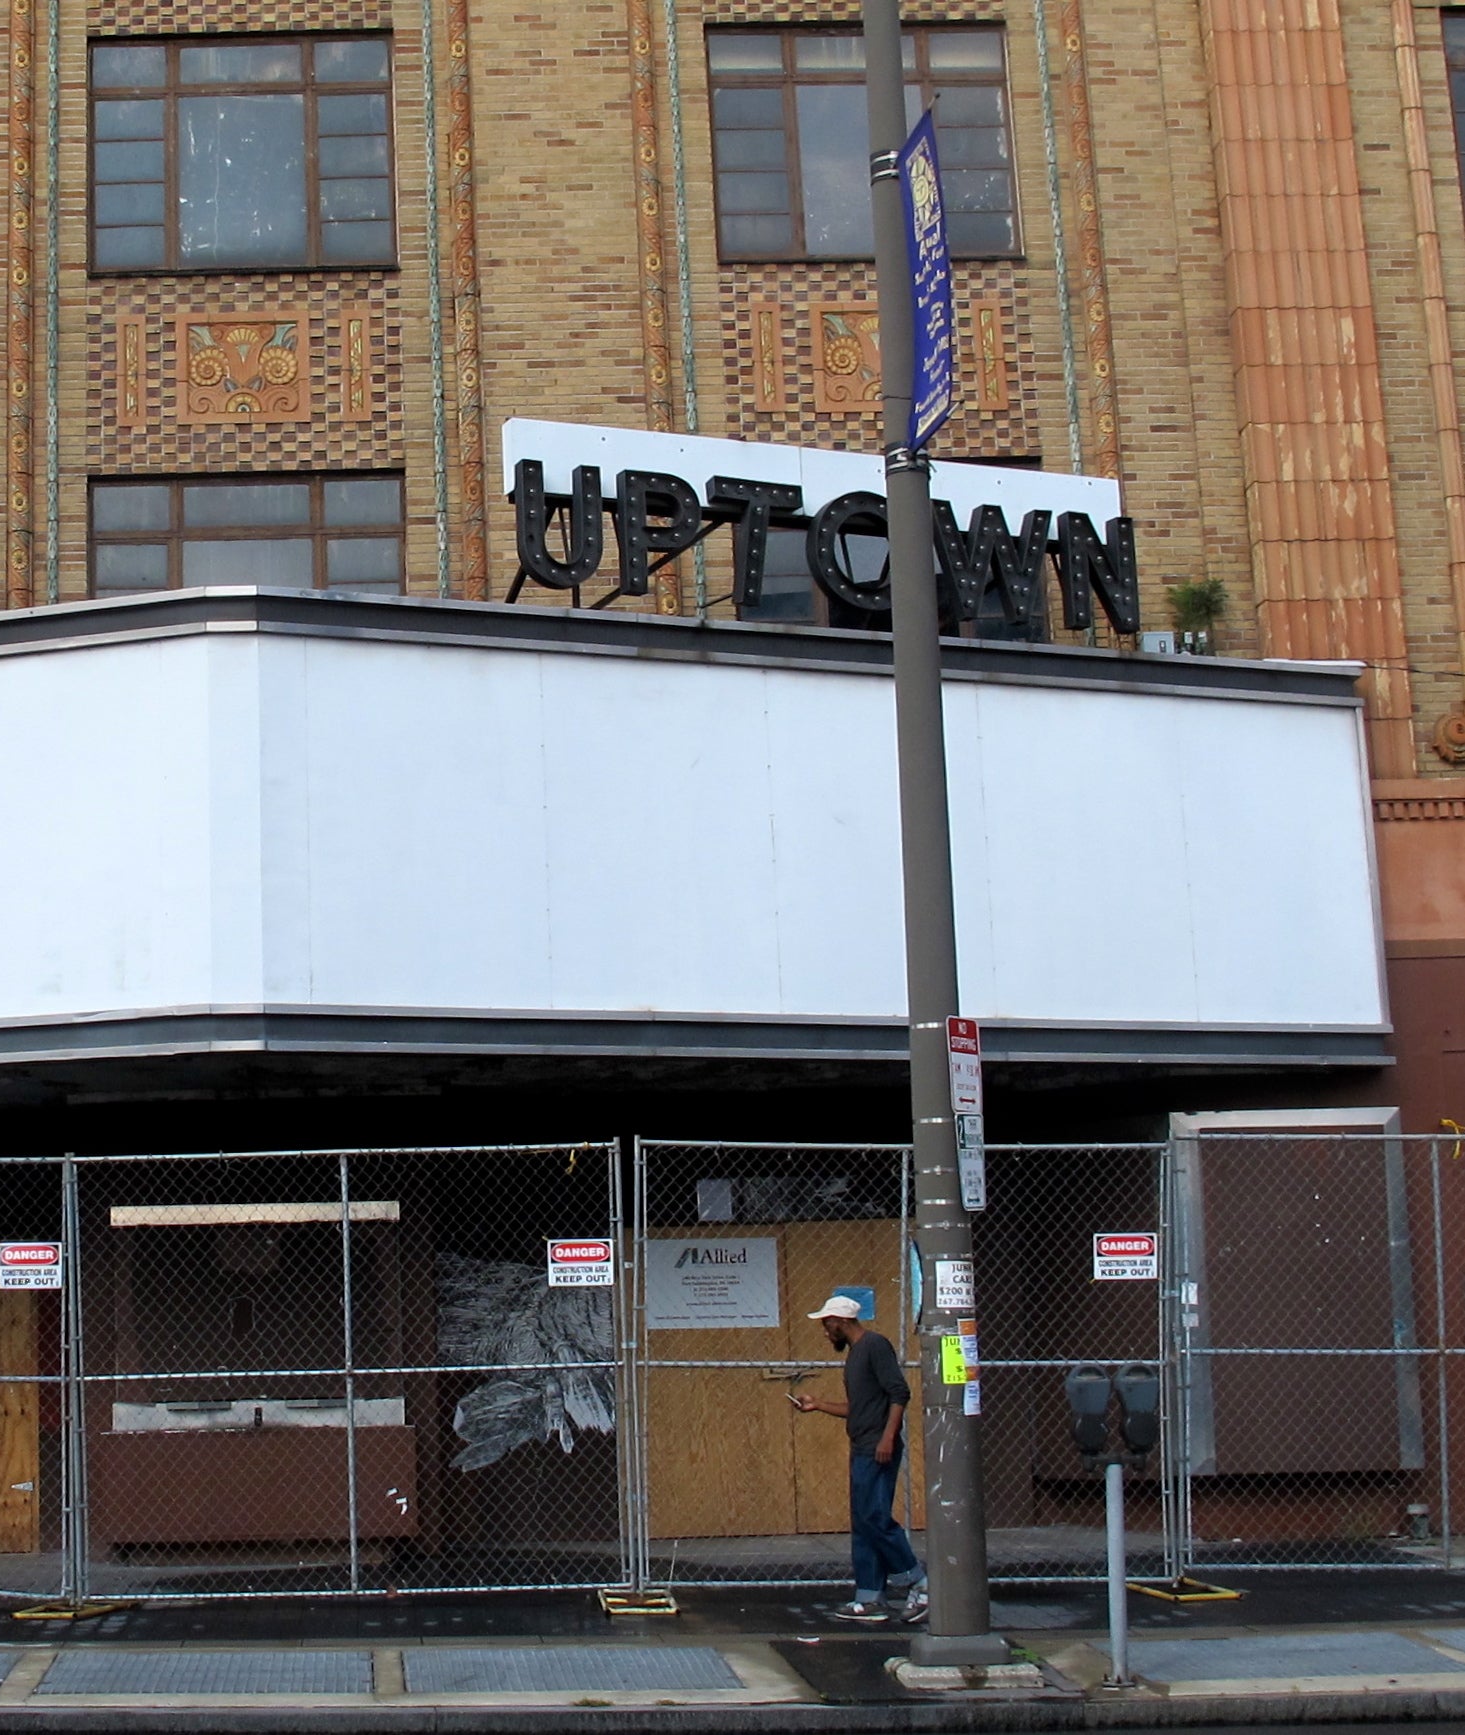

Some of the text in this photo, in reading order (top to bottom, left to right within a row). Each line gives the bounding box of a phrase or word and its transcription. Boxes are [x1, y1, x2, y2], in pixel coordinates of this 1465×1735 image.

[515, 459, 1140, 634] UPTOWN
[1100, 1241, 1150, 1251] DANGER
[4, 1250, 54, 1260] DANGER
[555, 1247, 605, 1258] DANGER
[700, 1247, 747, 1265] Allied
[1139, 1259, 1153, 1267] AREA
[44, 1268, 57, 1276] AREA
[553, 1265, 609, 1274] CONSTRUCTION AREA
[1100, 1268, 1150, 1277] KEEP OUT
[4, 1278, 56, 1286] KEEP OUT
[555, 1274, 607, 1283] KEEP OUT
